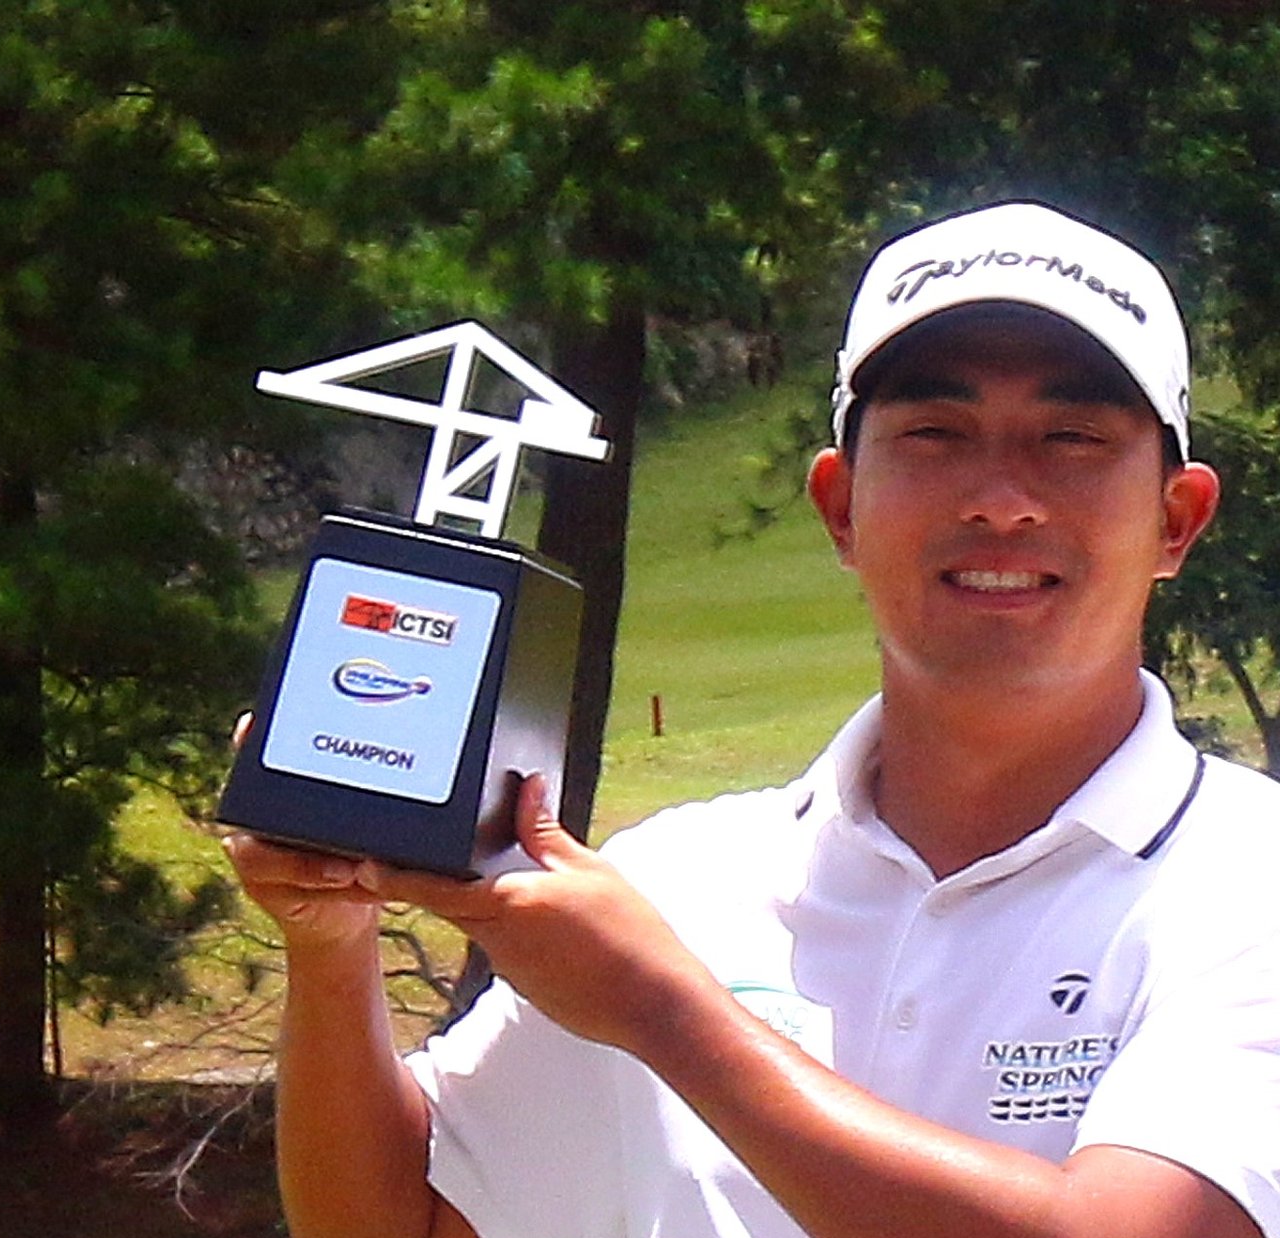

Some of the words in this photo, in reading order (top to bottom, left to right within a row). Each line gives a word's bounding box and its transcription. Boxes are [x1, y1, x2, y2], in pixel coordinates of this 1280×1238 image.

[886, 249, 1147, 325] TaylorMade
[392, 608, 455, 641] ICTSI
[313, 734, 415, 770] CHAMPION
